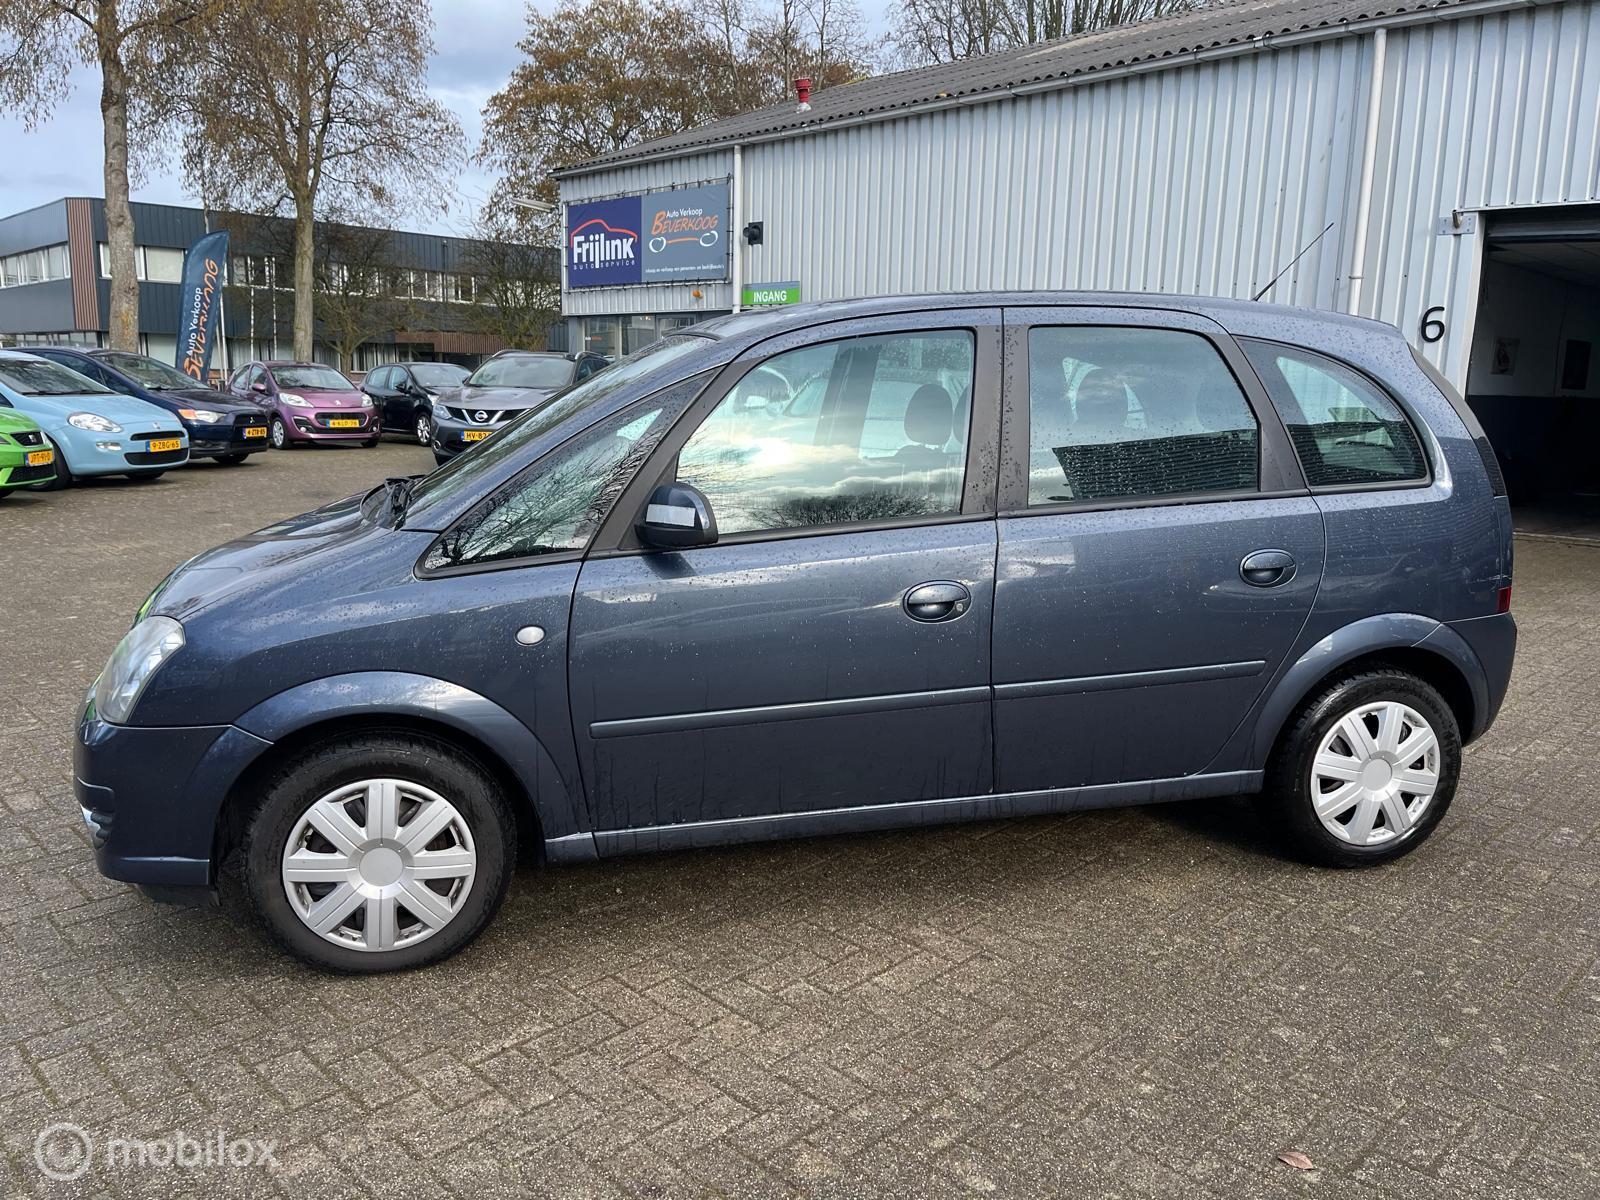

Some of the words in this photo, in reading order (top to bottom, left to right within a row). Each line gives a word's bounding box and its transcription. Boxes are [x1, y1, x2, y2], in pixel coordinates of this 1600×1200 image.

[651, 210, 719, 235] BEVERKOOG
[666, 210, 679, 218] Auto
[679, 207, 703, 217] Verkoop
[188, 287, 203, 331] Verkoop
[753, 290, 787, 303] INGANG
[1420, 306, 1445, 343] 6
